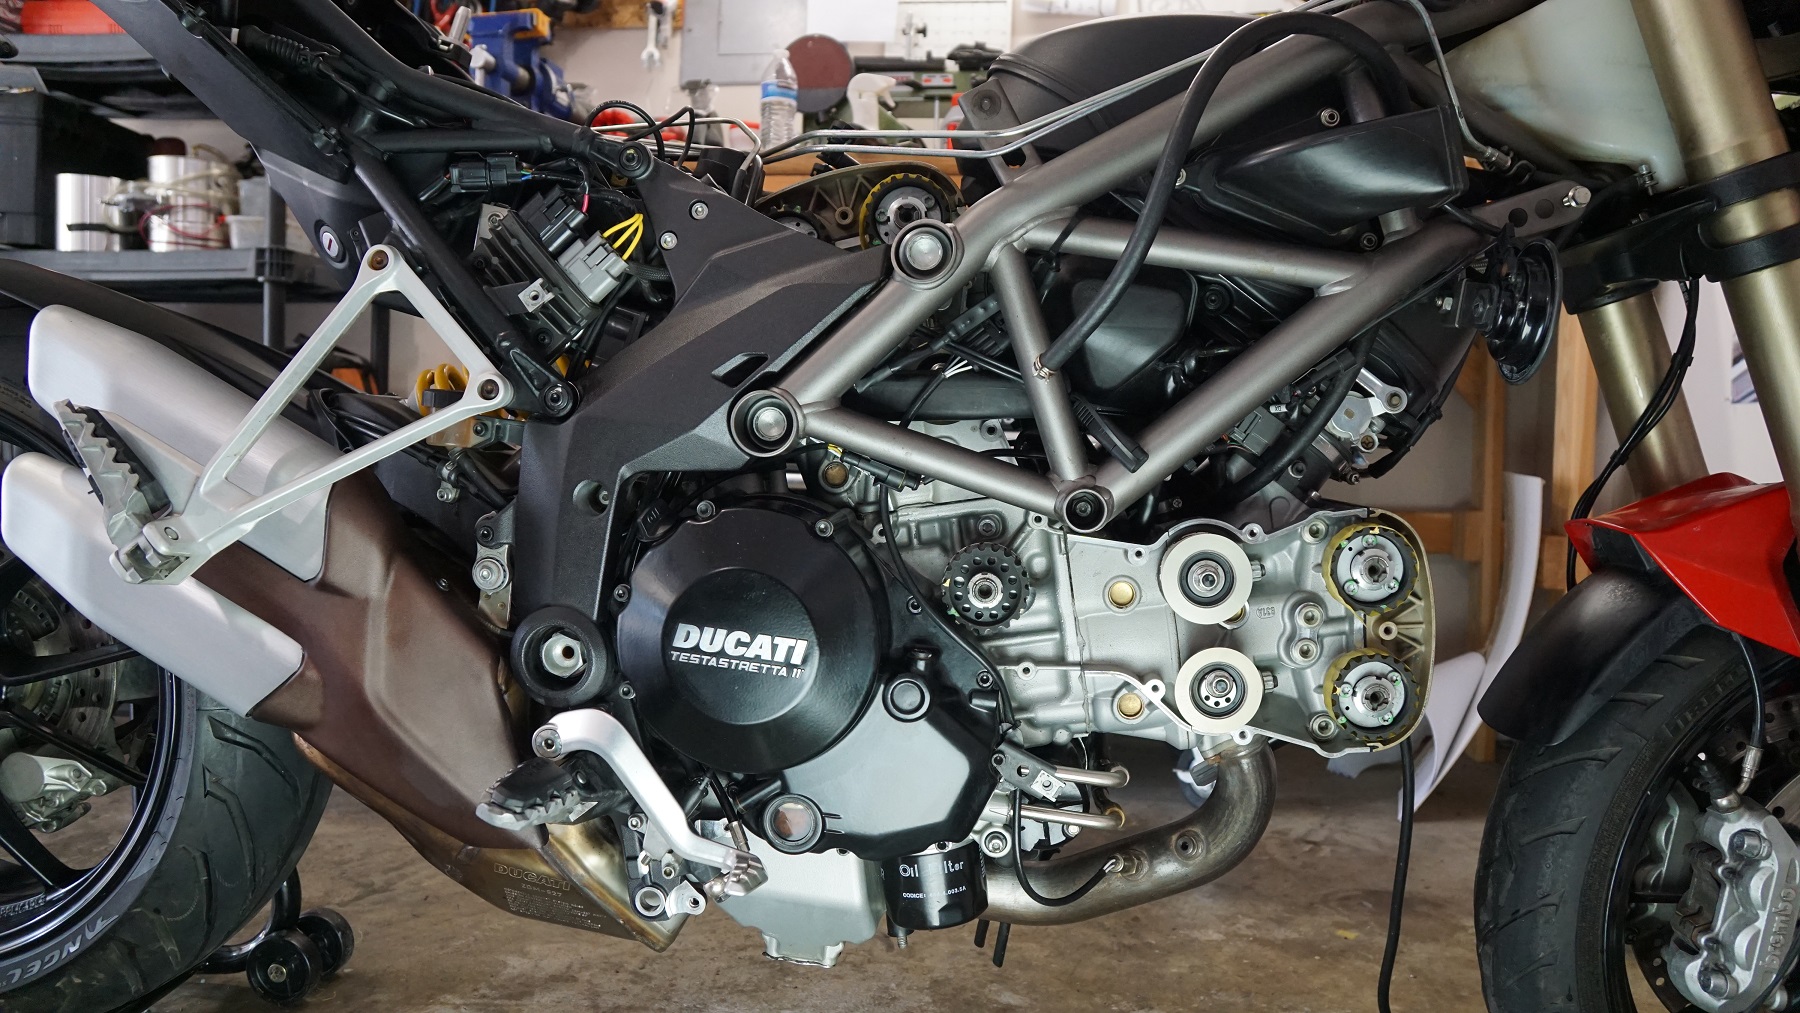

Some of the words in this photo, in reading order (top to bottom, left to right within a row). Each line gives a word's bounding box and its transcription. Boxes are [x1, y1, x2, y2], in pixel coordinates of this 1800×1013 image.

[672, 622, 808, 666] DUCATI
[670, 651, 788, 678] TESTASTRETTA
[493, 863, 571, 891] DUCATI
[899, 864, 919, 877] Oil
[1759, 887, 1796, 969] brembo
[7, 914, 119, 983] ANGEL
